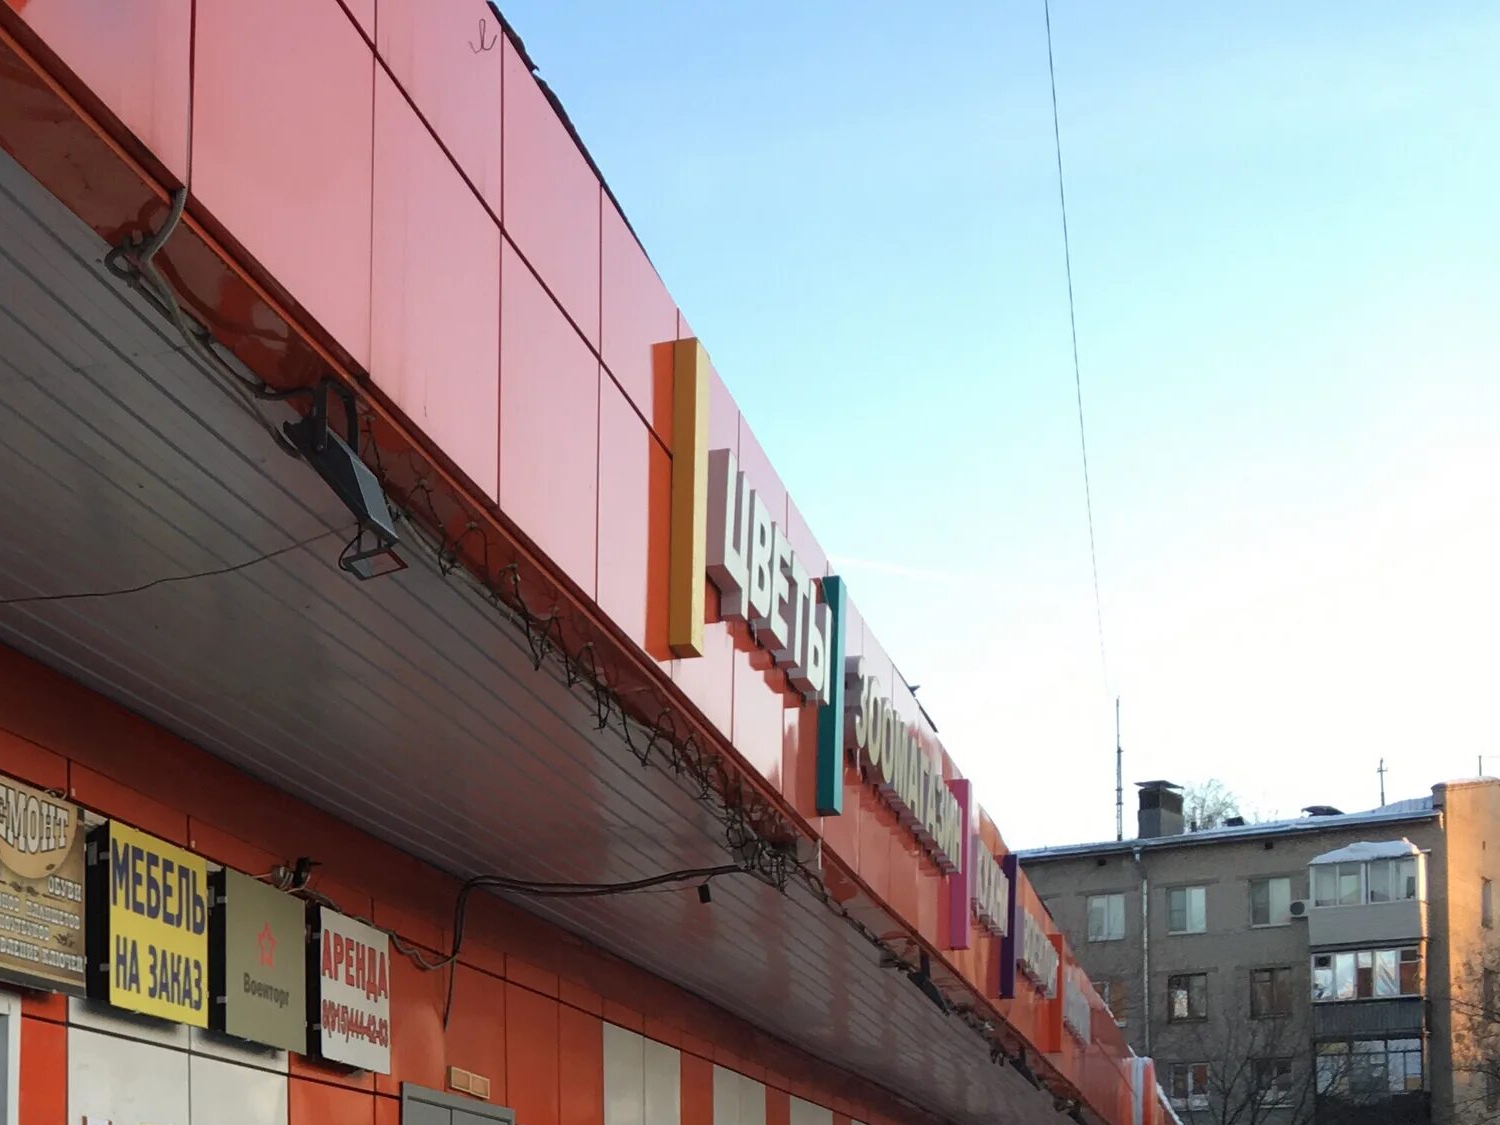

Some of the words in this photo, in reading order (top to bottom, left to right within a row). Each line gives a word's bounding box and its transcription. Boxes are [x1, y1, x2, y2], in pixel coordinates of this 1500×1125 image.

[714, 448, 834, 706] ЦВЕТЫ
[47, 875, 82, 903] ОБУВИ
[111, 837, 206, 936] МЕБЕЛЬ
[114, 934, 142, 994] НА
[147, 944, 203, 1012] ЗАКАЗ
[243, 972, 290, 1009] Военторг
[322, 928, 389, 1003] АРЕНДА
